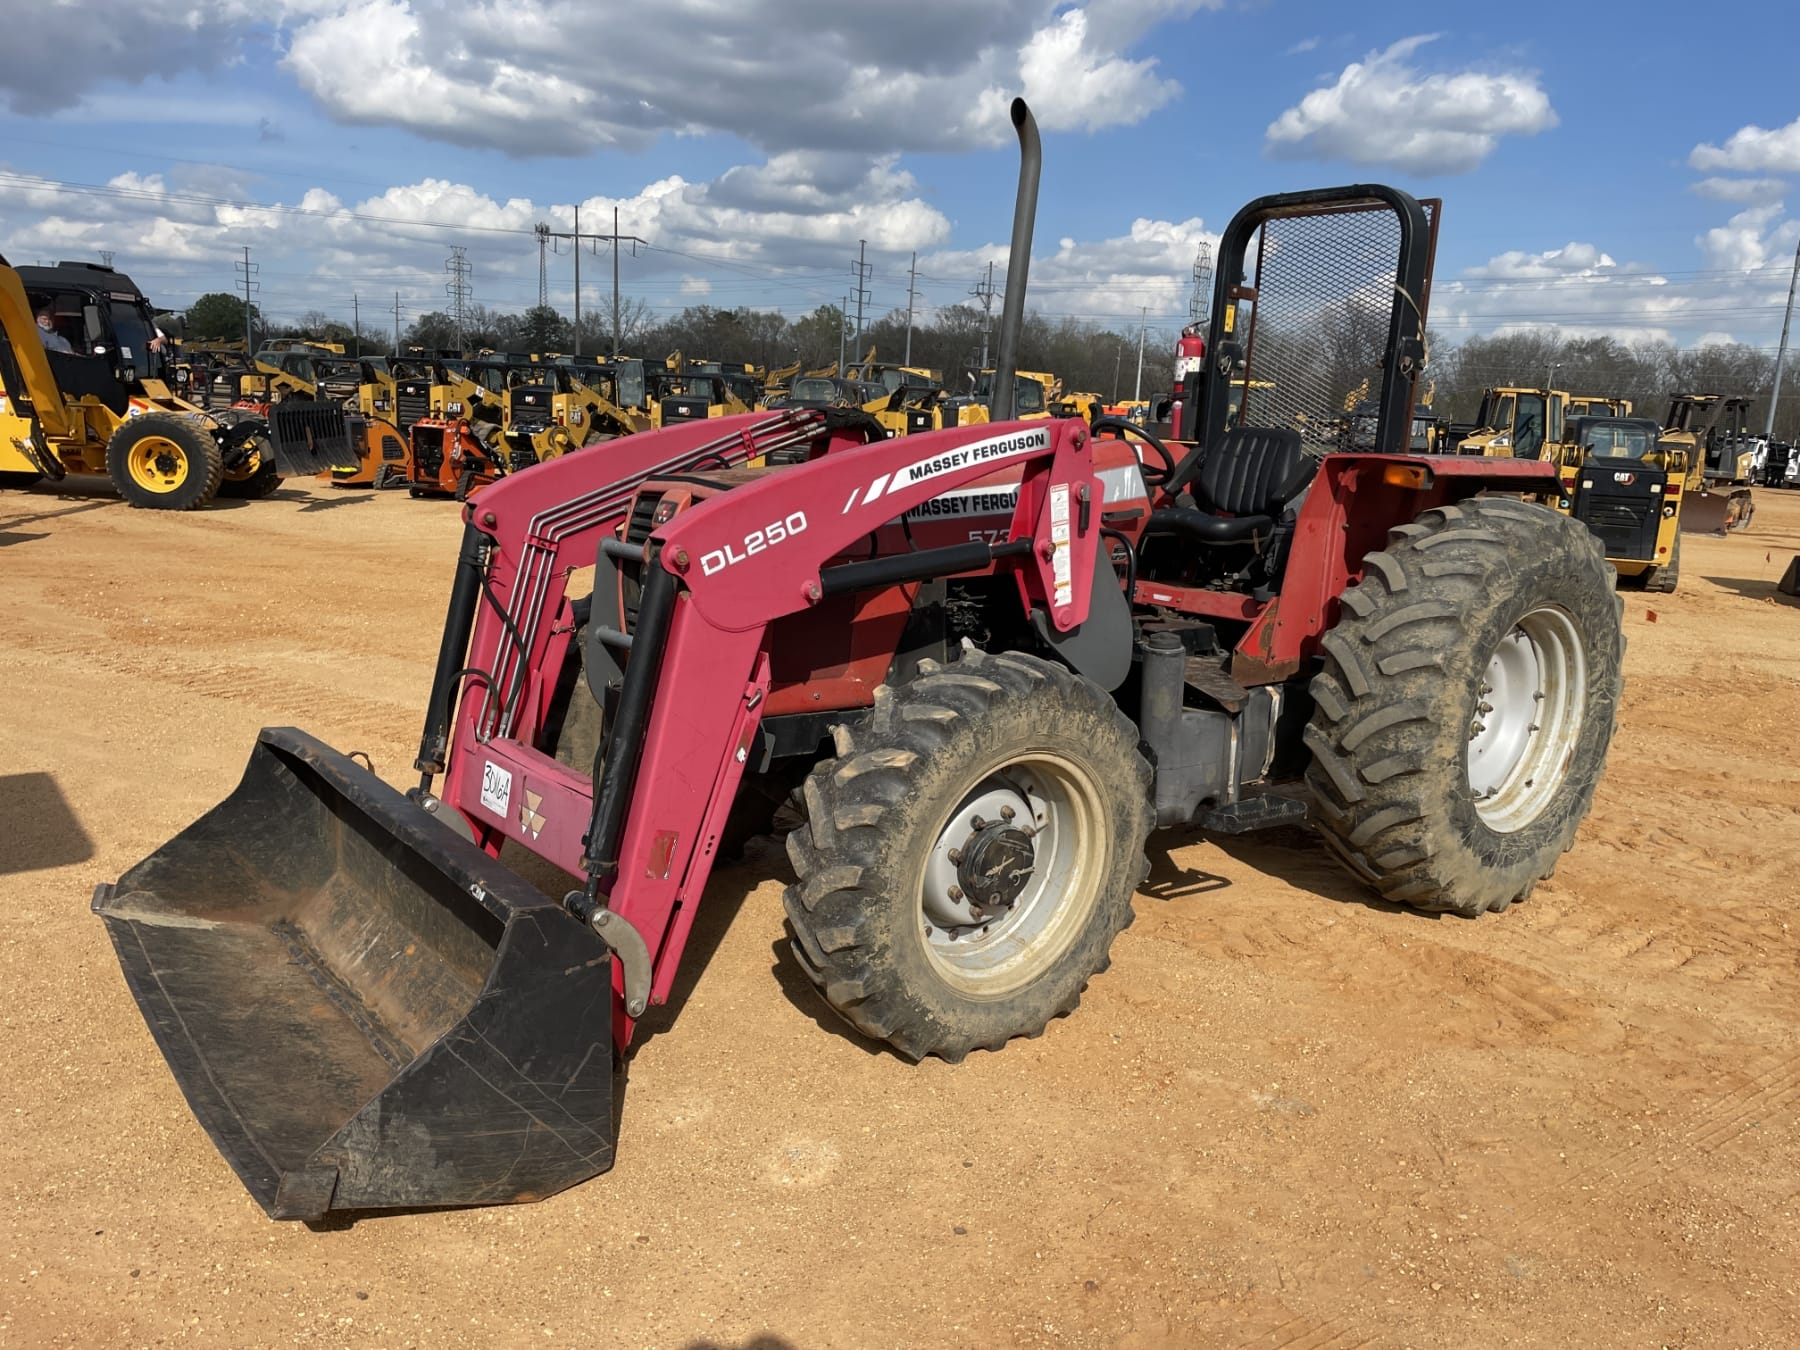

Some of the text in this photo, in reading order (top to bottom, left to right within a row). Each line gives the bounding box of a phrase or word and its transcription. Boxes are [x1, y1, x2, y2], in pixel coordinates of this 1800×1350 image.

[909, 434, 1045, 480] MASSEY FERGUSON
[1614, 472, 1630, 481] CAT
[907, 496, 970, 518] MASSEY
[700, 511, 807, 576] DL250
